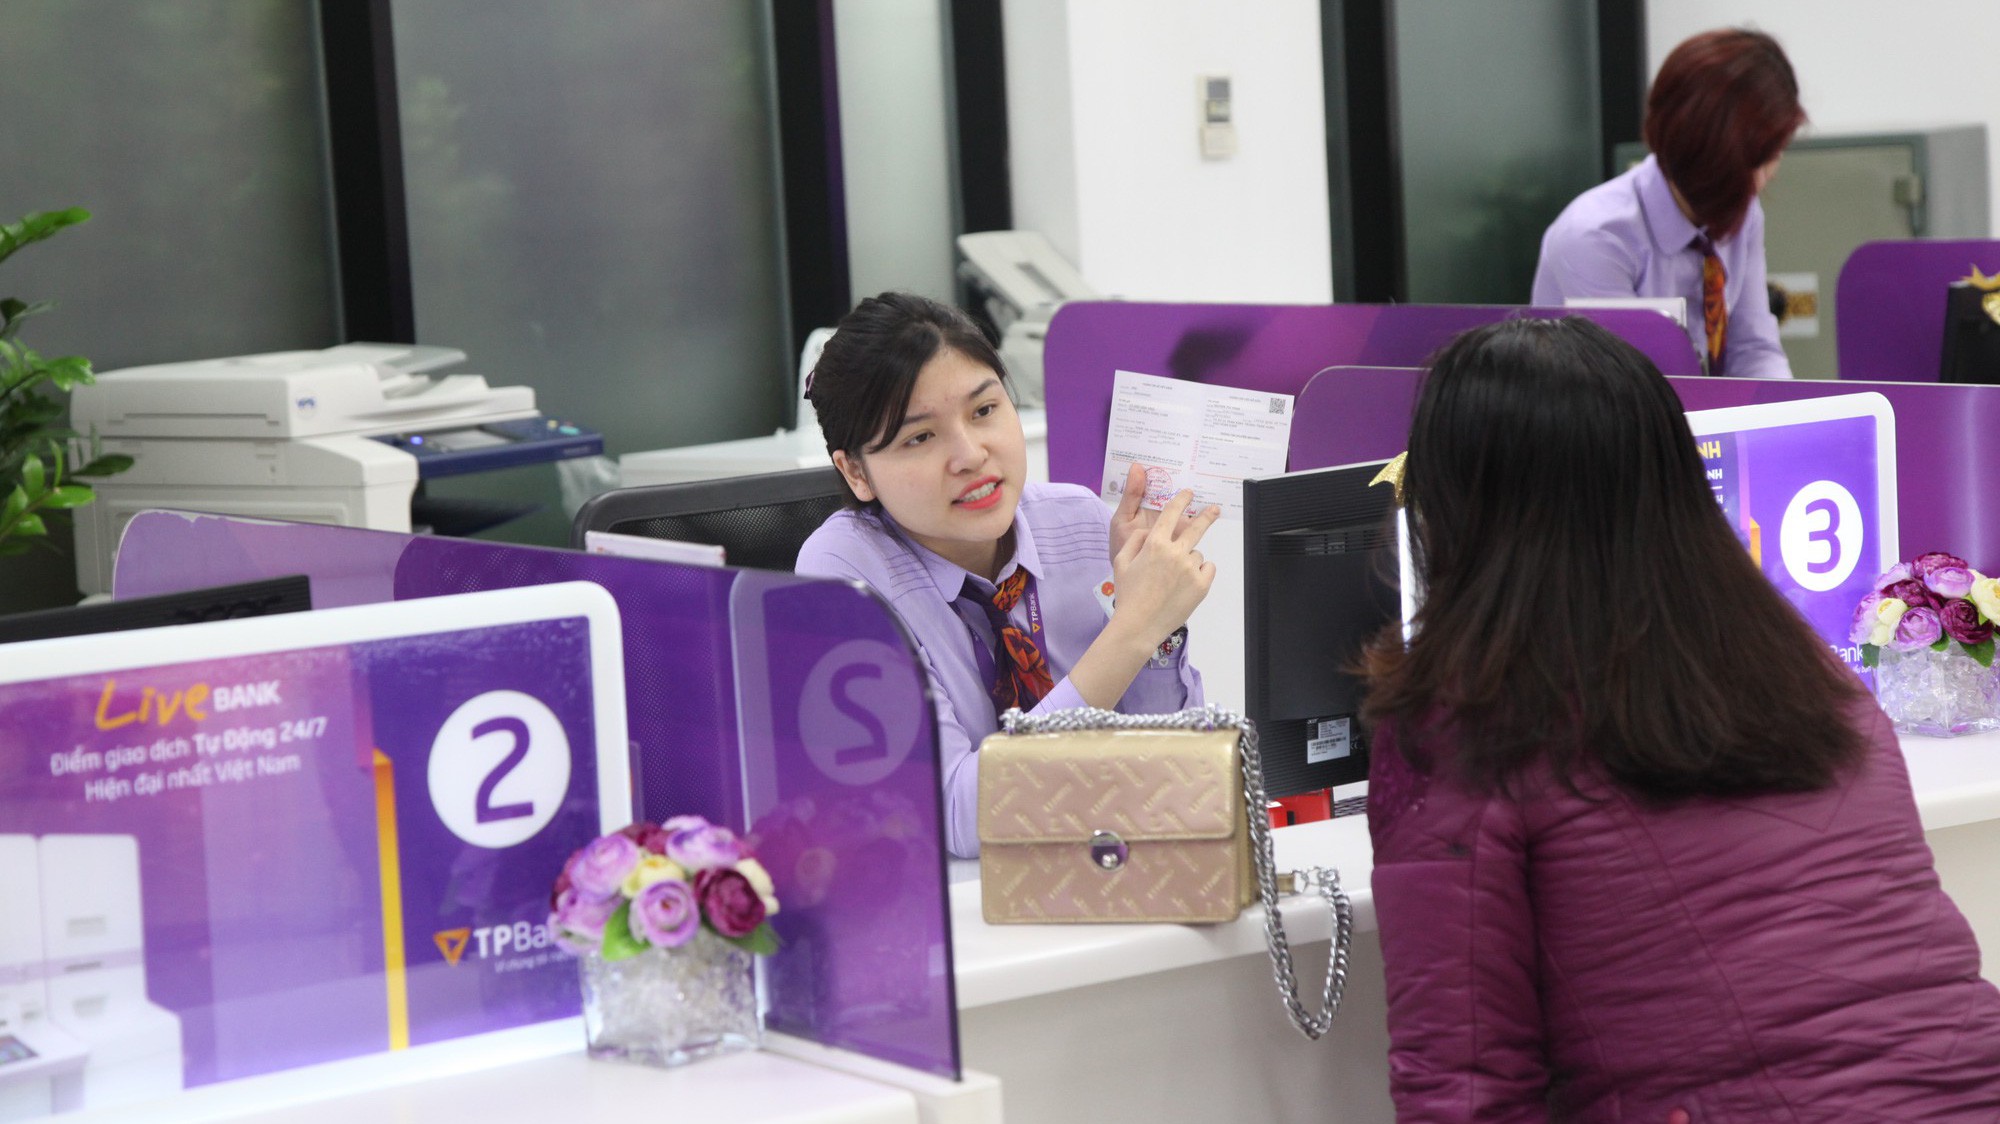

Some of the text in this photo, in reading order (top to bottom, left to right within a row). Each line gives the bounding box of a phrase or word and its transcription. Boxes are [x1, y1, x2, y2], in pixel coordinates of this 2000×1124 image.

[1805, 498, 1842, 574] 3
[1830, 643, 1864, 663] ank
[95, 679, 282, 730] Live BANK
[104, 745, 147, 774] giao
[279, 716, 327, 743] 24/7
[256, 753, 302, 777] Nam
[471, 716, 534, 824] 2
[473, 920, 549, 959] TPBa
